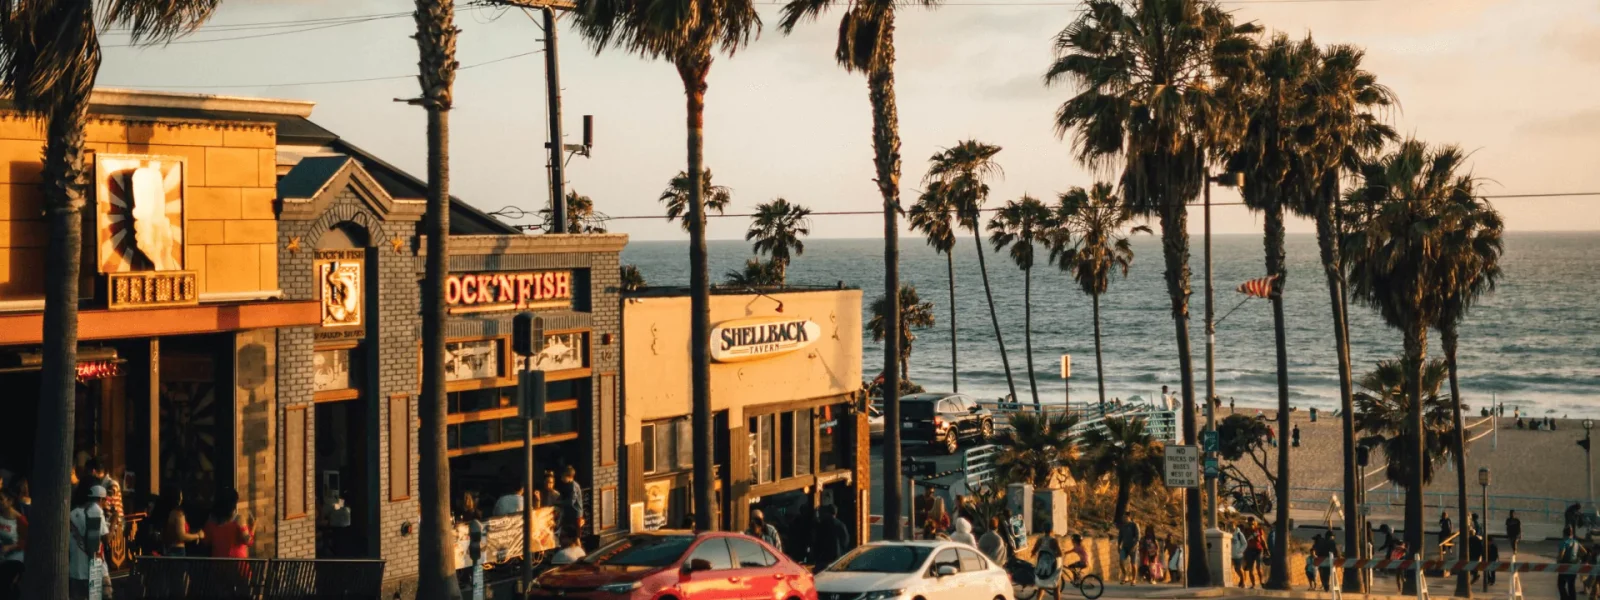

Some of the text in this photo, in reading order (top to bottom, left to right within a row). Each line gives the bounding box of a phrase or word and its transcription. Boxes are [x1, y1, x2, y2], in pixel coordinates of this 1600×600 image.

[347, 250, 364, 259] FISH
[445, 273, 515, 304] OCK'N
[720, 320, 808, 351] SHELLBACK
[749, 344, 780, 354] TAVERN
